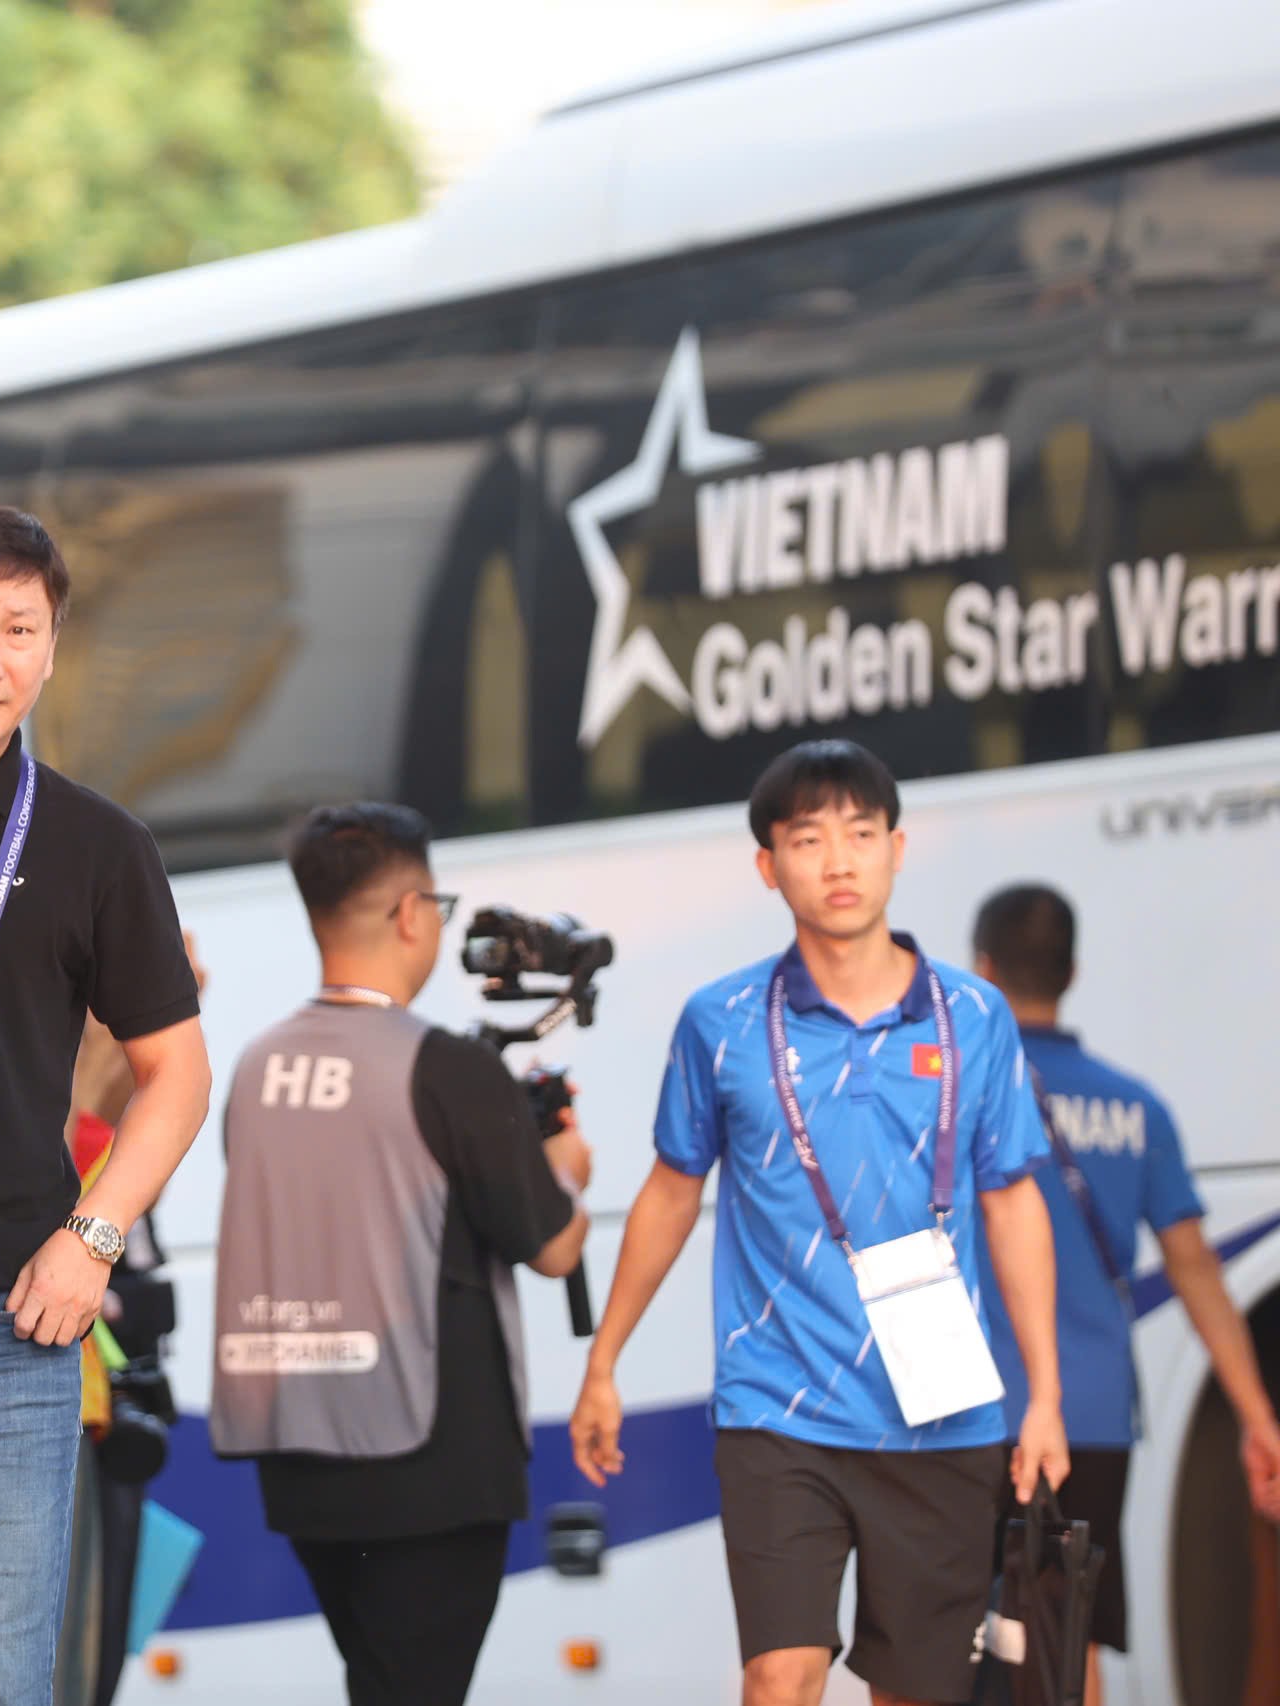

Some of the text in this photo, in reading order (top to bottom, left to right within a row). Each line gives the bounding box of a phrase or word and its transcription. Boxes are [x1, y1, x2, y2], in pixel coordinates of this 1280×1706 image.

[695, 433, 1010, 600] VIETNAM
[691, 552, 1280, 741] Golden Star Warr
[3, 826, 25, 876] FOOTBALL
[17, 759, 36, 828] CONFEDERATION
[261, 1053, 354, 1111] HB
